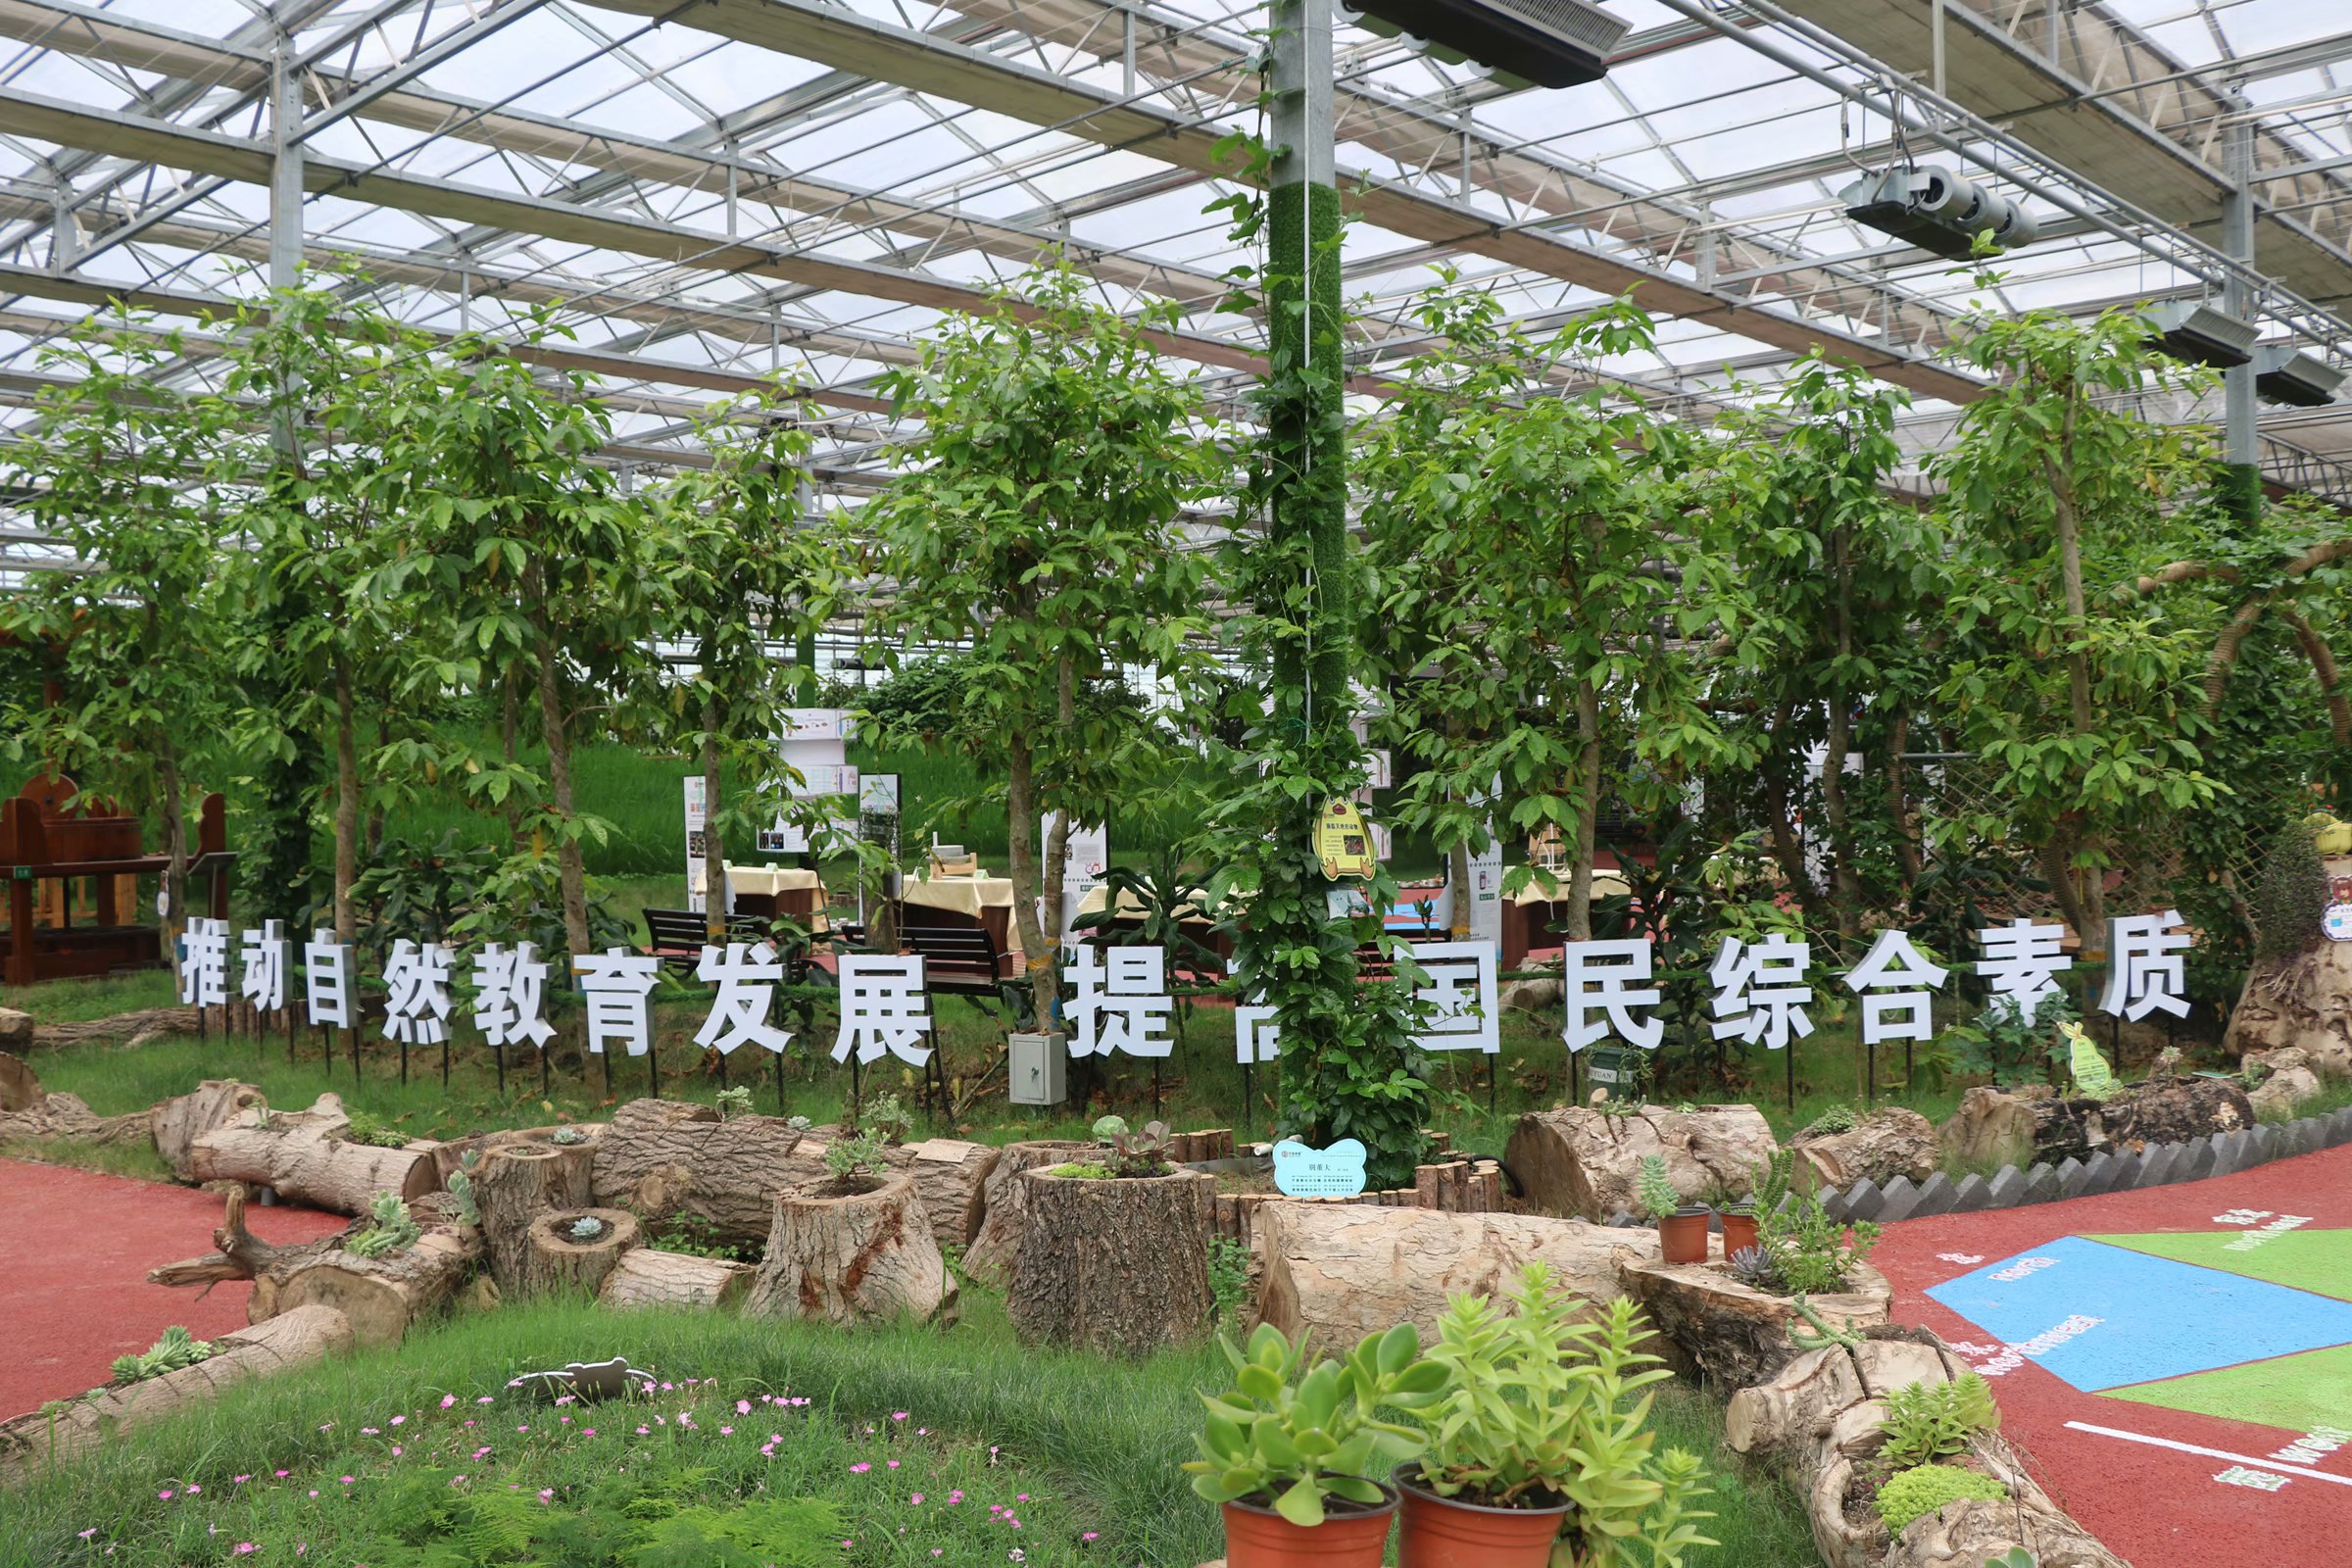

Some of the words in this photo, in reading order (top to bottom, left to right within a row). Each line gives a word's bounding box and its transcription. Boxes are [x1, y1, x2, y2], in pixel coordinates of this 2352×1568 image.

[181, 915, 936, 1067] 推动自然教育发展
